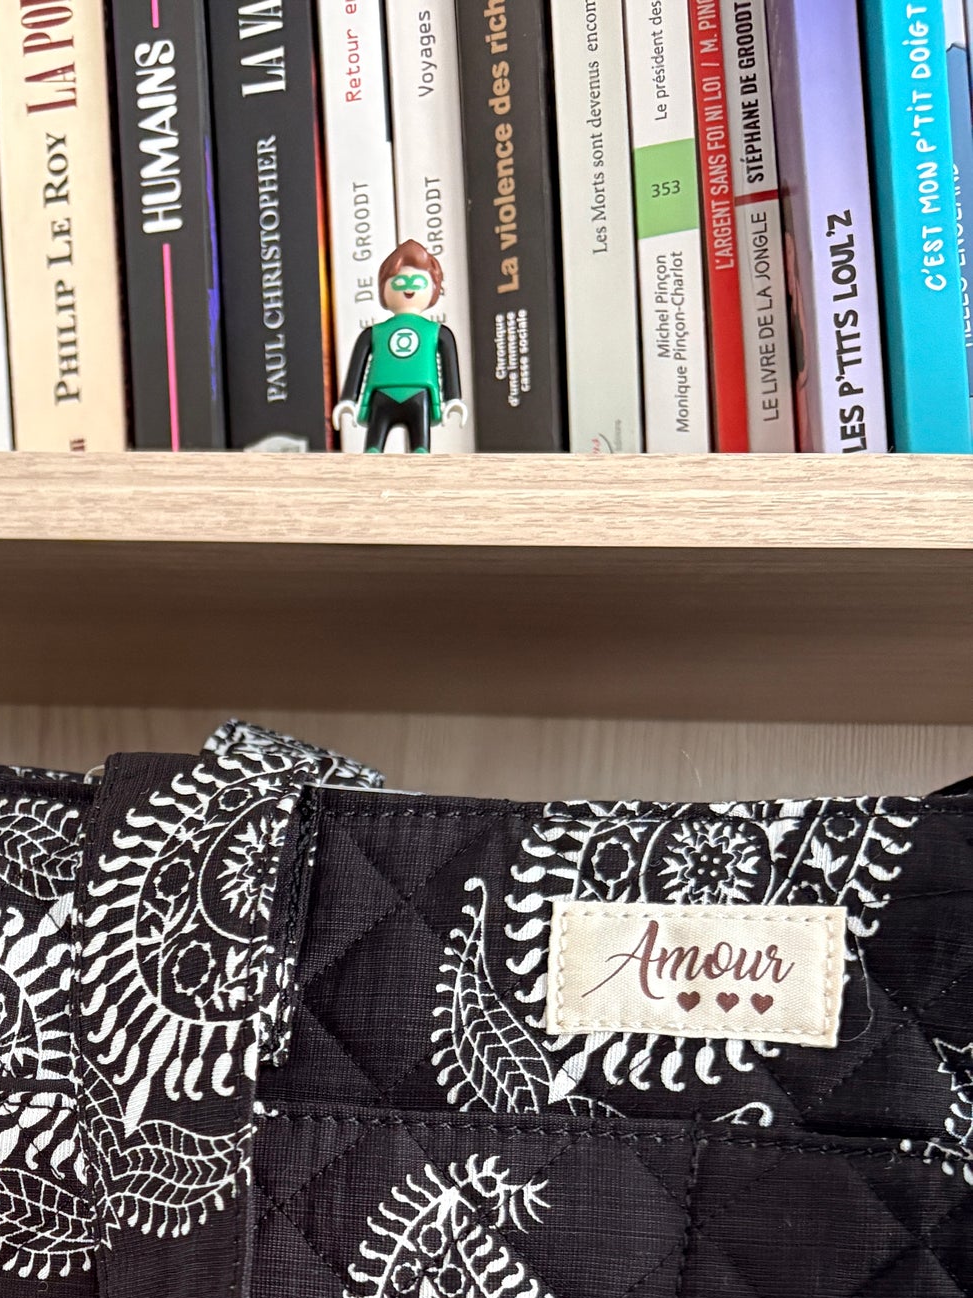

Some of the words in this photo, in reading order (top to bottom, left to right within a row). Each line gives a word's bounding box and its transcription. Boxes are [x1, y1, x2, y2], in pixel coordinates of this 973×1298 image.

[20, 0, 74, 57] PO
[345, 0, 357, 15] e
[648, 0, 663, 26] des
[418, 9, 437, 98] Voyages
[733, 1, 756, 70] GROODT
[23, 61, 78, 115] LA
[239, 45, 286, 98] LA
[344, 28, 362, 103] Retour
[488, 60, 513, 116] des
[649, 29, 670, 100] président
[702, 75, 722, 102] LOI
[740, 72, 758, 97] DE
[586, 59, 603, 129] devenus
[655, 103, 668, 121] Le
[704, 103, 724, 123] NI
[134, 39, 184, 234] HUMAINS
[589, 131, 604, 168] sont
[706, 125, 726, 151] FOI
[739, 98, 765, 185] STÉPHANE
[43, 132, 69, 209] ROY
[493, 122, 518, 250] violence
[590, 170, 606, 222] Morts
[651, 179, 681, 198] 353
[707, 153, 729, 195] SANS
[916, 161, 942, 214] MON
[47, 216, 73, 269] LE
[256, 134, 285, 330] CHRISTOPHER
[352, 182, 372, 262] GROODT
[424, 176, 444, 257] GROODT
[592, 225, 608, 255] Les
[711, 199, 735, 271] L'ARGENT
[751, 210, 772, 280] JONGLE
[826, 209, 859, 303] LOUL'Z
[921, 225, 948, 292] C'EST
[354, 275, 373, 303] DE
[497, 256, 520, 294] La
[655, 254, 672, 305] Pinçon
[757, 284, 774, 312] LA
[669, 250, 690, 362] Pinçon-Charlot
[758, 314, 775, 341] DE
[54, 279, 82, 406] PHILIP
[655, 310, 671, 359] Michel
[833, 308, 865, 398] P'TITS
[265, 333, 287, 403] PAUL
[760, 343, 778, 396] LIVRE
[675, 365, 692, 433] Monique
[763, 397, 779, 422] LE
[839, 404, 867, 453] LES
[581, 920, 795, 1001] Amour
